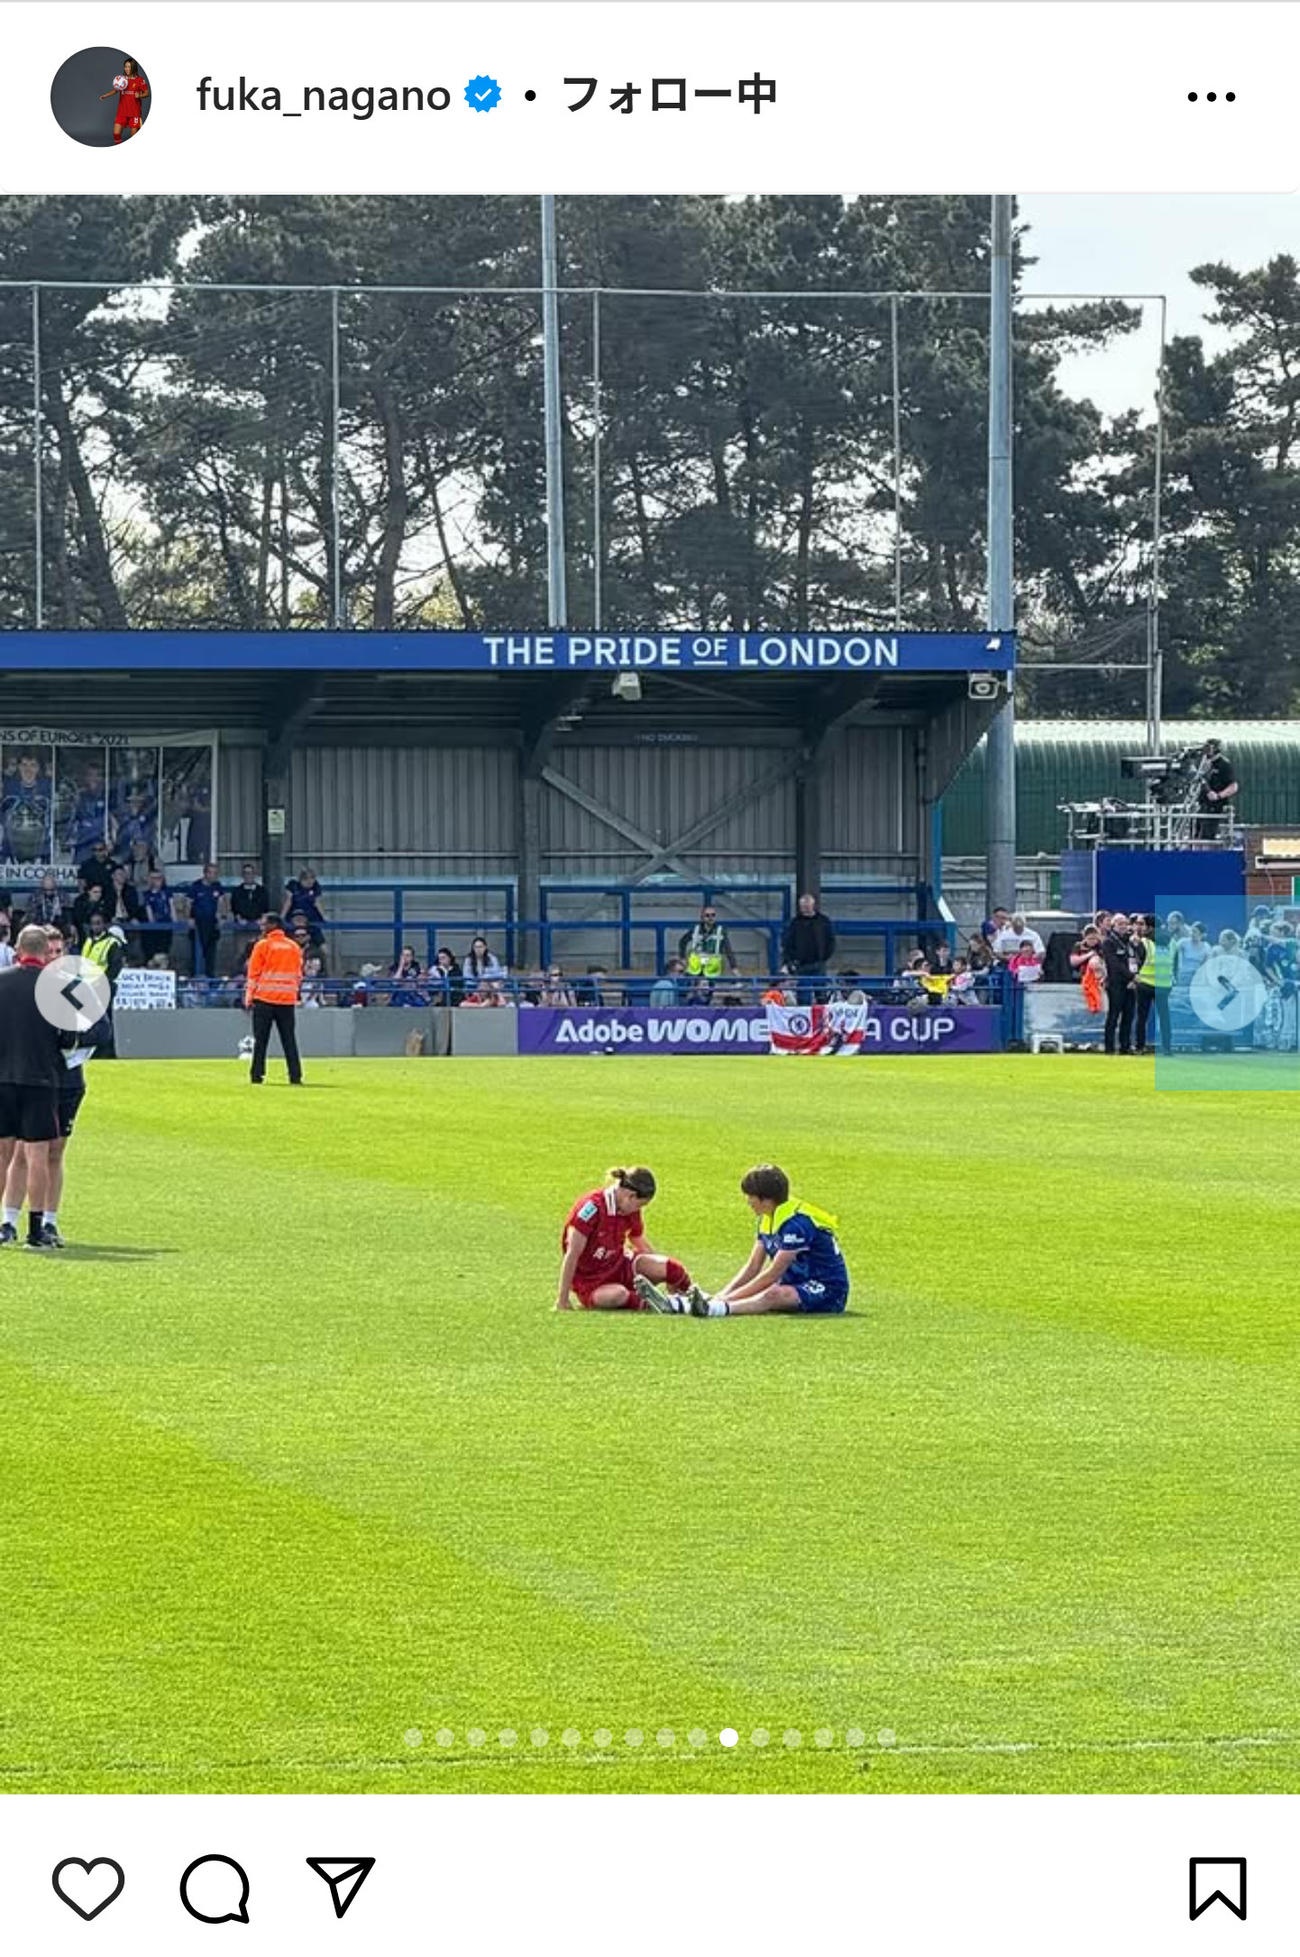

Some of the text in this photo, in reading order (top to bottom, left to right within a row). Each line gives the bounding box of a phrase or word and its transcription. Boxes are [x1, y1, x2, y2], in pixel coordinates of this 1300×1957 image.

[483, 637, 897, 666] THE PRIDE OF LONDON
[555, 1018, 644, 1042] Adobe
[648, 1018, 770, 1042] WOME
[890, 1017, 956, 1041] CUP
